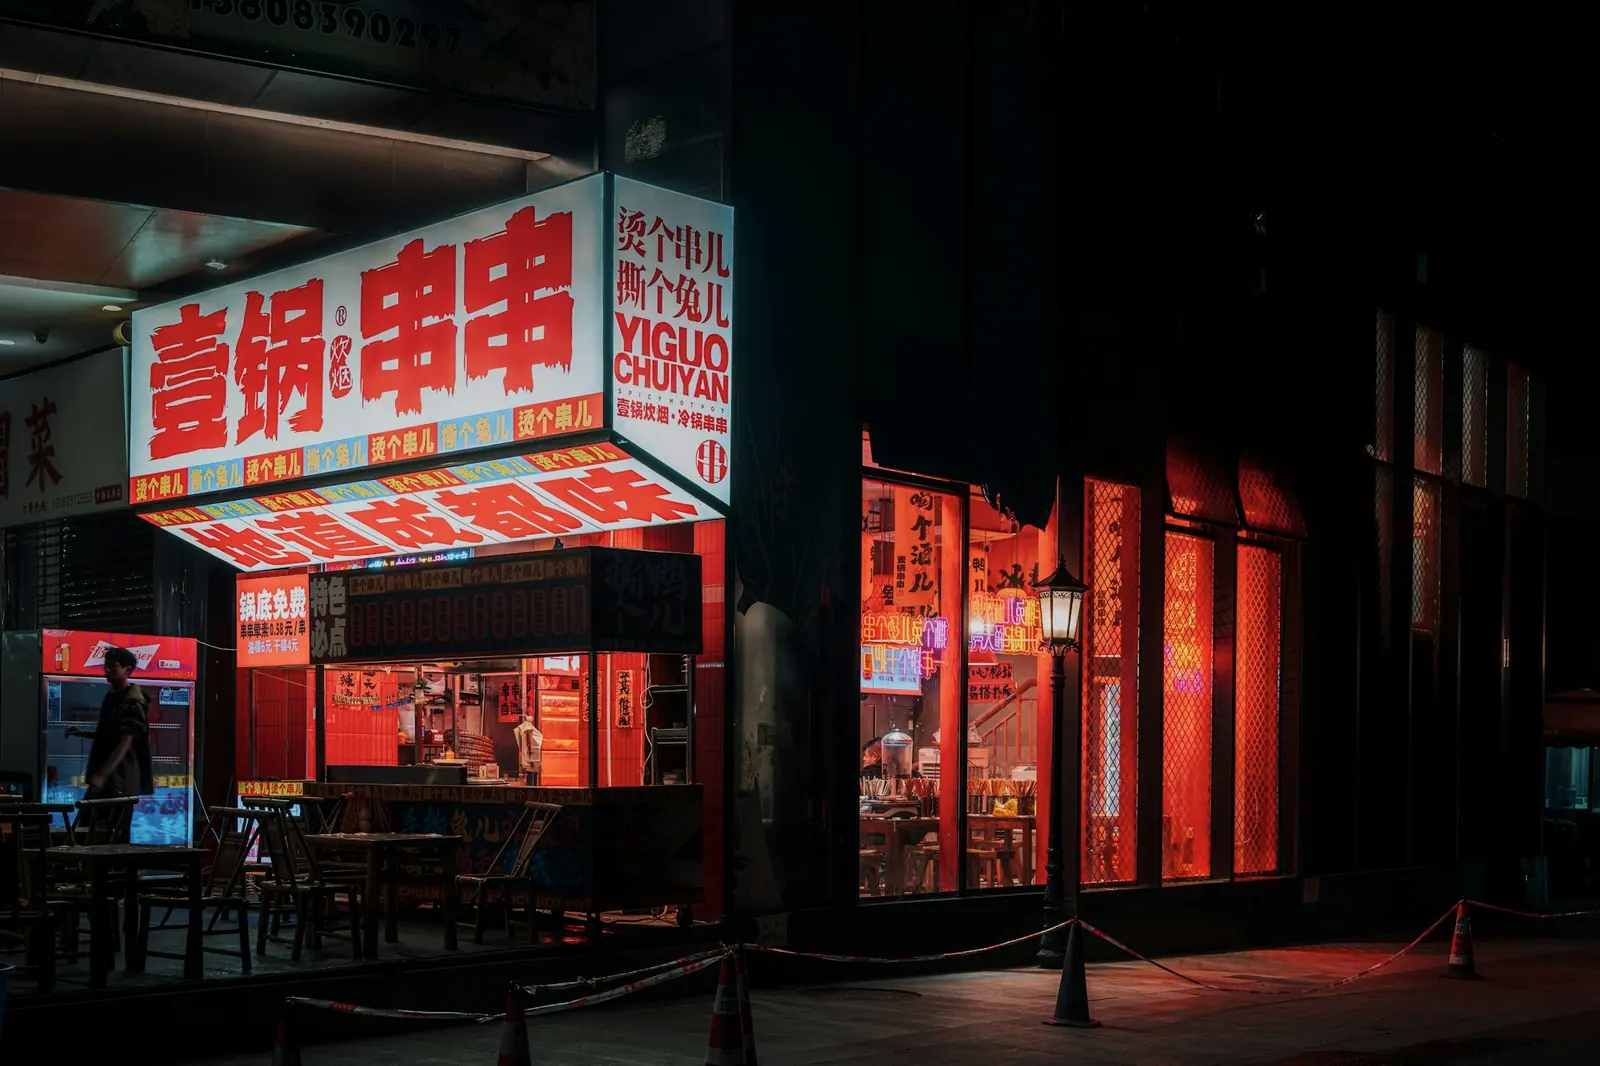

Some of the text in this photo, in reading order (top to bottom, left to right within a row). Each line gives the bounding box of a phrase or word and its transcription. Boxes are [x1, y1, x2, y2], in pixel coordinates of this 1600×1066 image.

[618, 205, 730, 278] 烫个串儿
[616, 258, 730, 328] 撕个兔儿
[149, 205, 574, 461] 壹锅 串串
[613, 311, 729, 374] YIGUO
[329, 335, 353, 397] 炊烟
[613, 351, 729, 405] CHUIYAN
[136, 473, 184, 502] 烫个串儿
[246, 454, 301, 483] 烫个串儿
[370, 429, 435, 462] 烫个串儿
[516, 401, 593, 439] 烫个串儿
[180, 464, 701, 569] 地道成都味
[239, 586, 307, 622] 锅底免费
[310, 576, 347, 617] 特色
[310, 617, 348, 659] 必点
